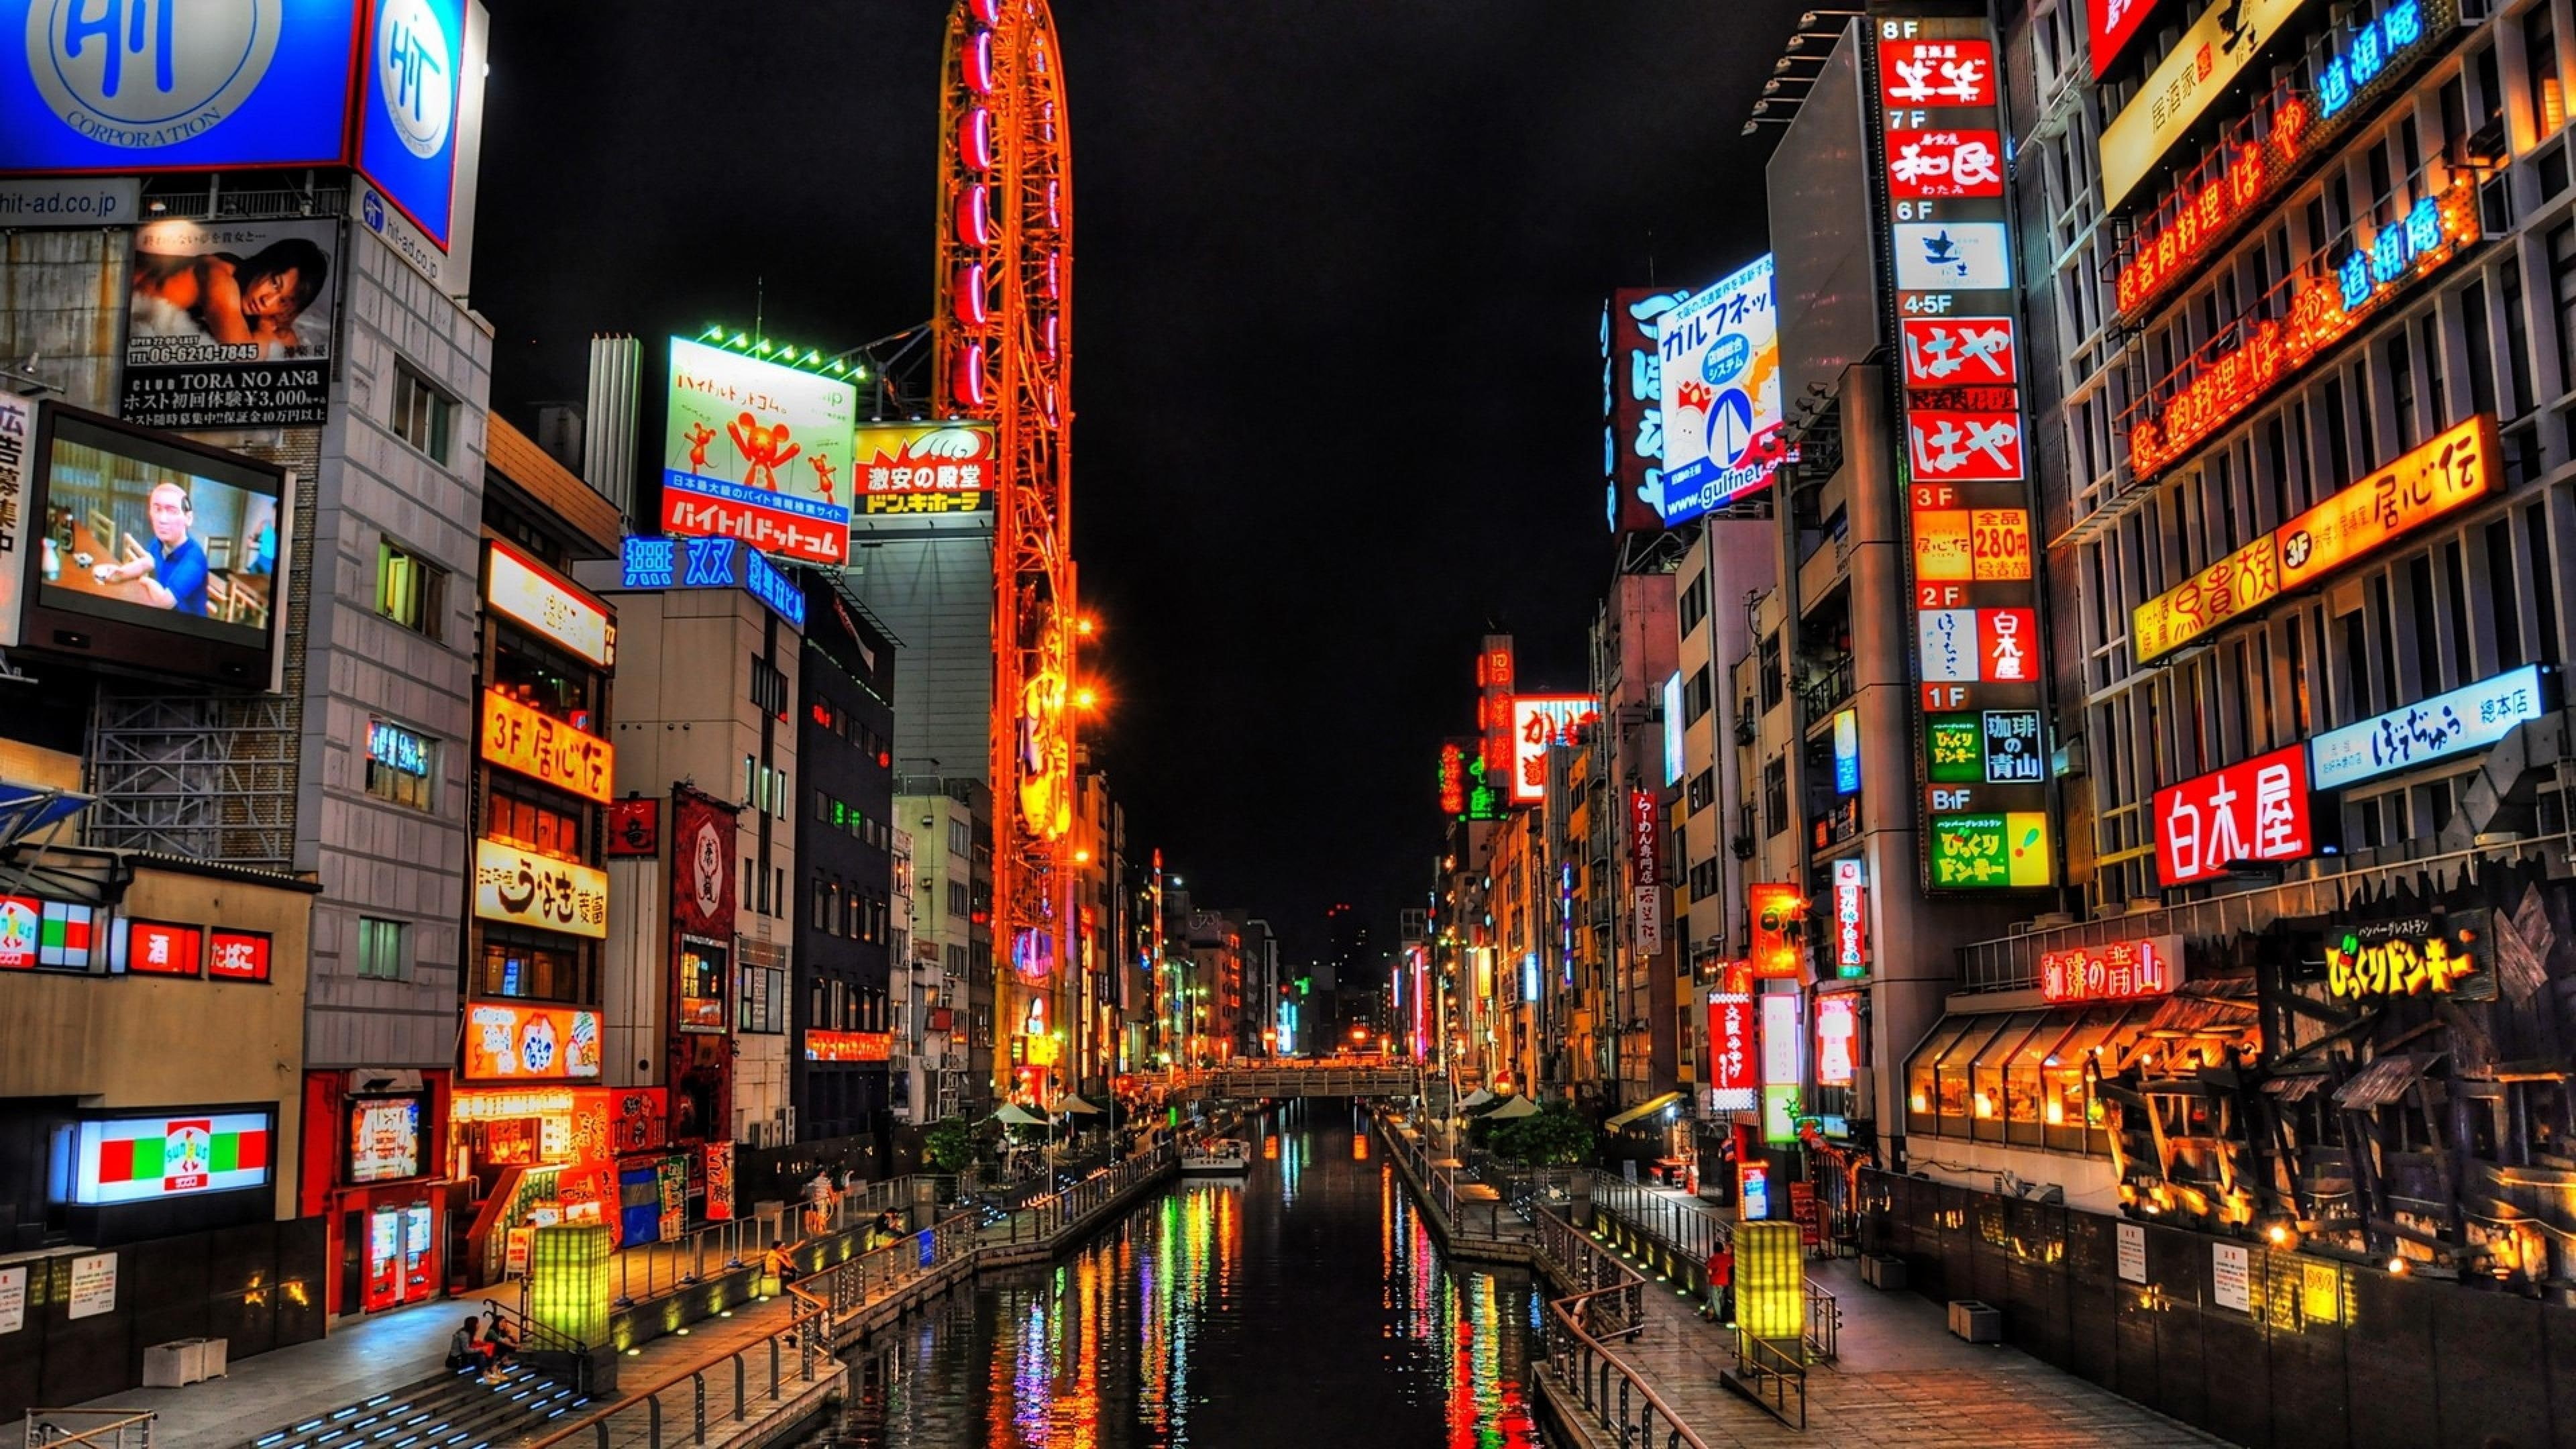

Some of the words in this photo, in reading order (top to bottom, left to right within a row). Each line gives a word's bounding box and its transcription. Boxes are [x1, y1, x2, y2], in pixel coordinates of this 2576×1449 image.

[66, 105, 222, 148] CORPORATION
[1890, 142, 2000, 186] 和民
[1921, 184, 1965, 195] わたみ
[386, 216, 439, 280] hit-ad.co.jp
[150, 344, 258, 363] 06-6214-7845
[1907, 327, 2011, 380] はや
[132, 379, 176, 391] CLUB
[180, 372, 235, 390] TORA
[241, 370, 272, 388] NO
[1912, 420, 2017, 474] はや
[867, 464, 981, 492] 激安の殿堂
[2374, 436, 2478, 532] 居心伝
[671, 500, 839, 557] バイトルドットコム
[1979, 512, 2021, 527] 全品
[1917, 537, 1970, 554] 居心伝
[2286, 533, 2309, 567] 3F
[1992, 610, 2026, 680] 白木屋
[1988, 714, 2037, 738] 珈琲
[494, 712, 523, 755] 3F
[533, 716, 604, 794] 居心伝
[2004, 737, 2023, 753] の
[1990, 752, 2038, 779] 青山
[1932, 789, 1972, 810] B1F
[2165, 762, 2302, 880] 白木屋
[1638, 796, 1654, 884] らーめん専門店
[1941, 833, 2000, 858] びっくり
[1939, 857, 2006, 883] ドンキー
[2358, 918, 2430, 938] ハンバーグレストラン
[147, 933, 170, 965] 酒
[2042, 941, 2164, 1001] 珈琲の青山
[2324, 938, 2477, 1001] びっくりドンキー
